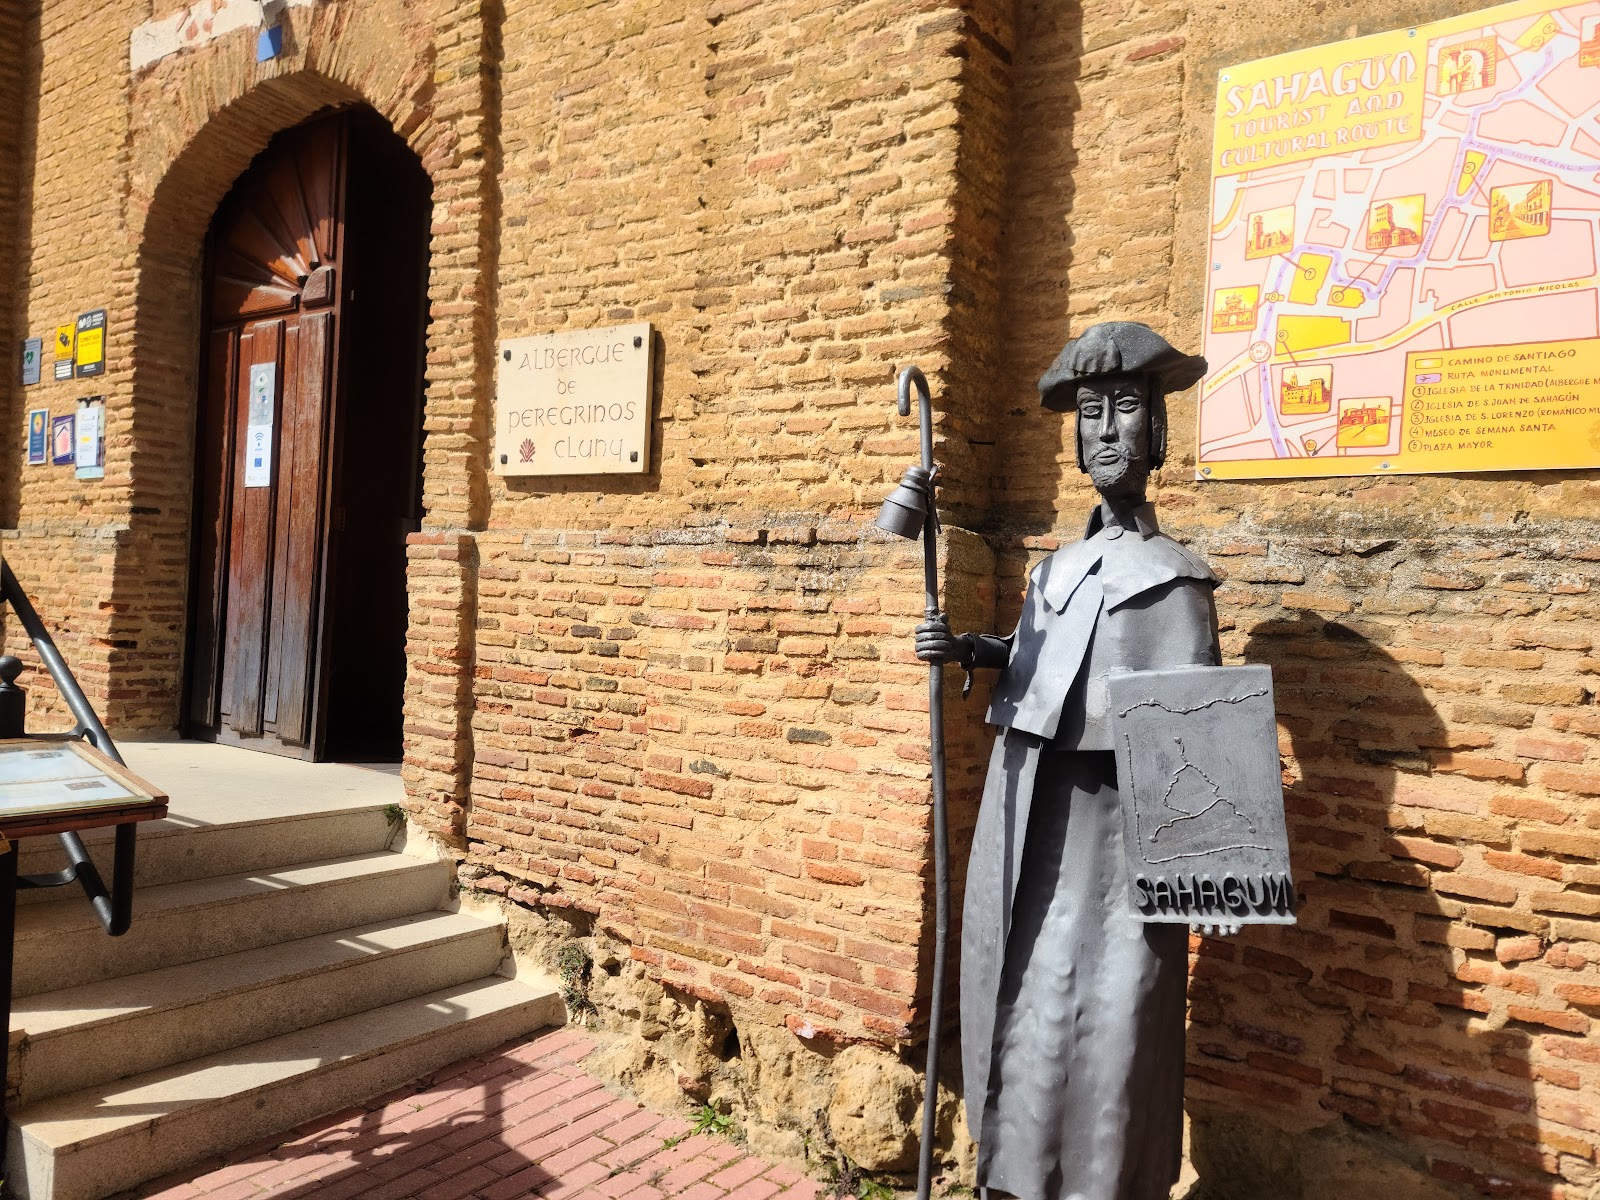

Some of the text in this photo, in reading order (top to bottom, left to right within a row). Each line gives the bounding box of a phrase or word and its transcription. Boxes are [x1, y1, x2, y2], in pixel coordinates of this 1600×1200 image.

[1223, 50, 1417, 119] SAHAGUN
[1232, 91, 1404, 139] TOURIST AND
[1220, 113, 1414, 168] CULTURAL ROUTE
[1476, 143, 1573, 171] ZONA COMERCIAL
[1450, 281, 1580, 311] CALLE ANTONIO NICOLAS
[517, 343, 625, 371] ALBERGUE
[1448, 349, 1576, 366] CAMINO DE SANTIAGO
[1447, 365, 1554, 380] RUTA MONUMENTAL
[557, 378, 577, 395] DE
[1427, 386, 1466, 395] IGLESIA
[1470, 384, 1480, 392] DE
[1499, 381, 1543, 390] TRINIDAD
[1425, 401, 1463, 410] IGLESIA
[1467, 400, 1480, 408] DE
[1534, 392, 1580, 403] SAHAGÚN
[508, 401, 636, 434] PEREGRINOS
[1424, 414, 1461, 423] IGLESIA
[1466, 413, 1477, 421] DE
[1491, 410, 1534, 419] LORENZO
[1425, 428, 1455, 437] MUSEO
[1459, 428, 1471, 436] DE
[1476, 426, 1515, 434] SEMANA
[1520, 424, 1556, 432] SANTA
[554, 437, 623, 461] CLUNY
[1423, 443, 1453, 451] PLAZA
[1458, 440, 1494, 450] MAYOR
[1132, 872, 1289, 909] SAHAGUN
